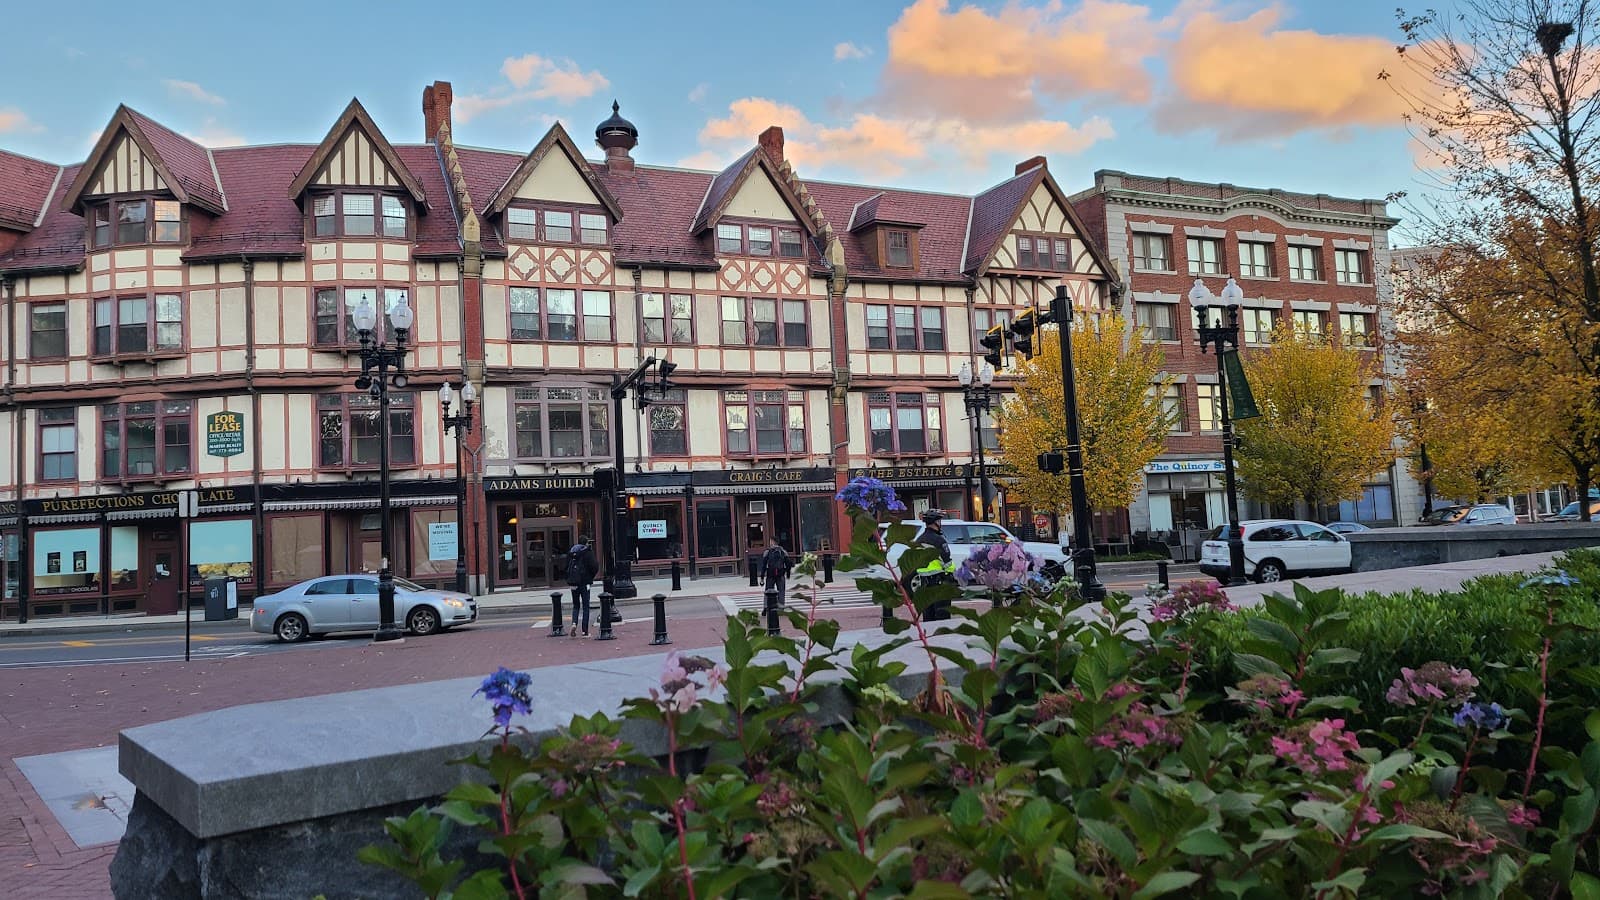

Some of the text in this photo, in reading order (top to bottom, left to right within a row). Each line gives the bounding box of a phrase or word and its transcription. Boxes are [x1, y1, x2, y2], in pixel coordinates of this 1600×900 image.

[214, 414, 236, 424] FOR
[209, 422, 241, 433] LEASE
[869, 467, 952, 478] THE ESTRING
[1172, 462, 1209, 472] Quincy
[729, 470, 802, 482] CRAIG'S CAFE
[489, 478, 595, 490] ADAMS BUILDIN
[43, 489, 236, 512] PUREFECTIONS CHOLATE
[0, 503, 17, 515] NG
